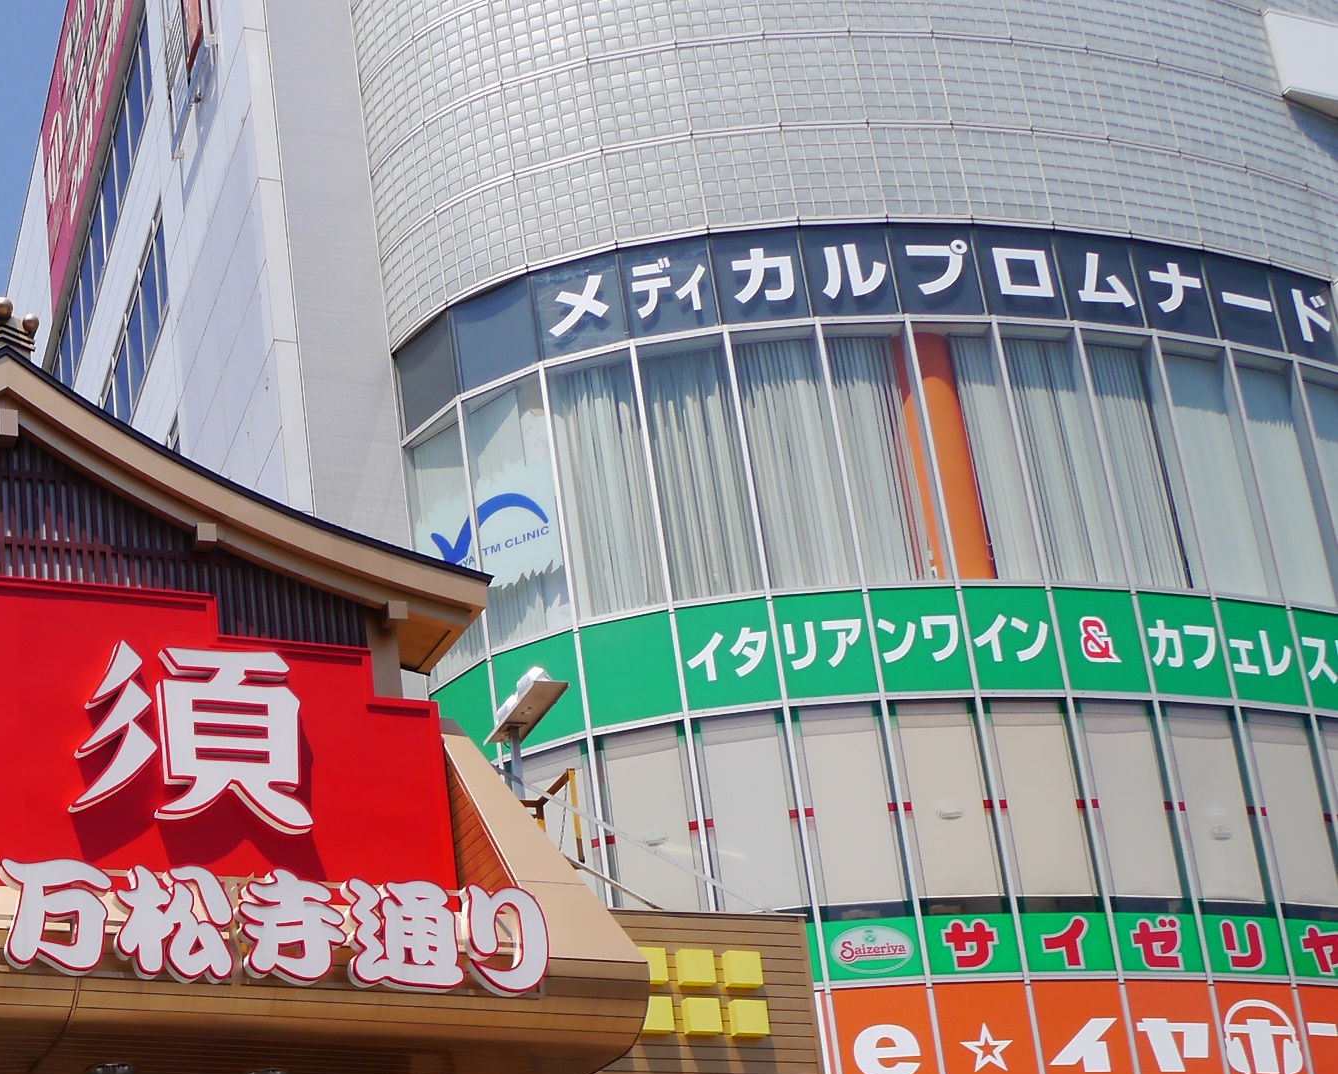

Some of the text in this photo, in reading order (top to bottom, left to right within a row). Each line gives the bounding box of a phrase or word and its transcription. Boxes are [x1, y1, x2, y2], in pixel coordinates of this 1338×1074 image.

[548, 239, 1333, 344] メディカルプロムナード
[483, 544, 501, 556] TM
[504, 526, 550, 549] CLINIC
[687, 613, 1338, 684] イタリアンワイン & カフェレス
[839, 941, 906, 962] Saizeriya
[941, 915, 1338, 975] サイゼリヤ
